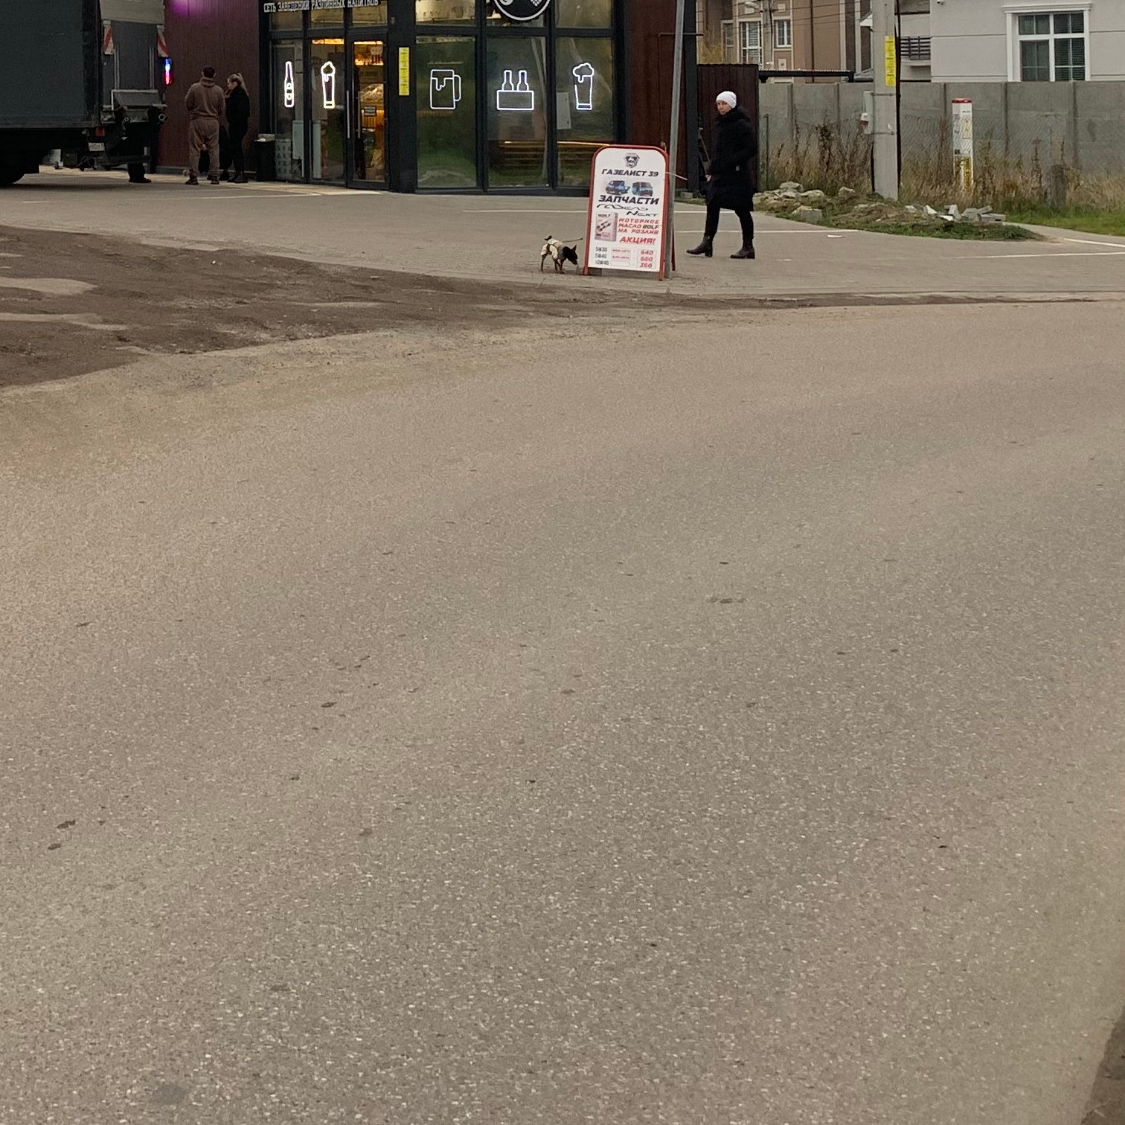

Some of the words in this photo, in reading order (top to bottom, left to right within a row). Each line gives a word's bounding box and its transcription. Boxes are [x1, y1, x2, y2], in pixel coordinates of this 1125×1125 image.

[264, 2, 277, 13] СЕТЬ
[601, 168, 647, 177] ГАЗЕЛИСТ
[598, 194, 660, 205] ЗАПЧАСТИ
[619, 236, 656, 245] АКЦИЯ!
